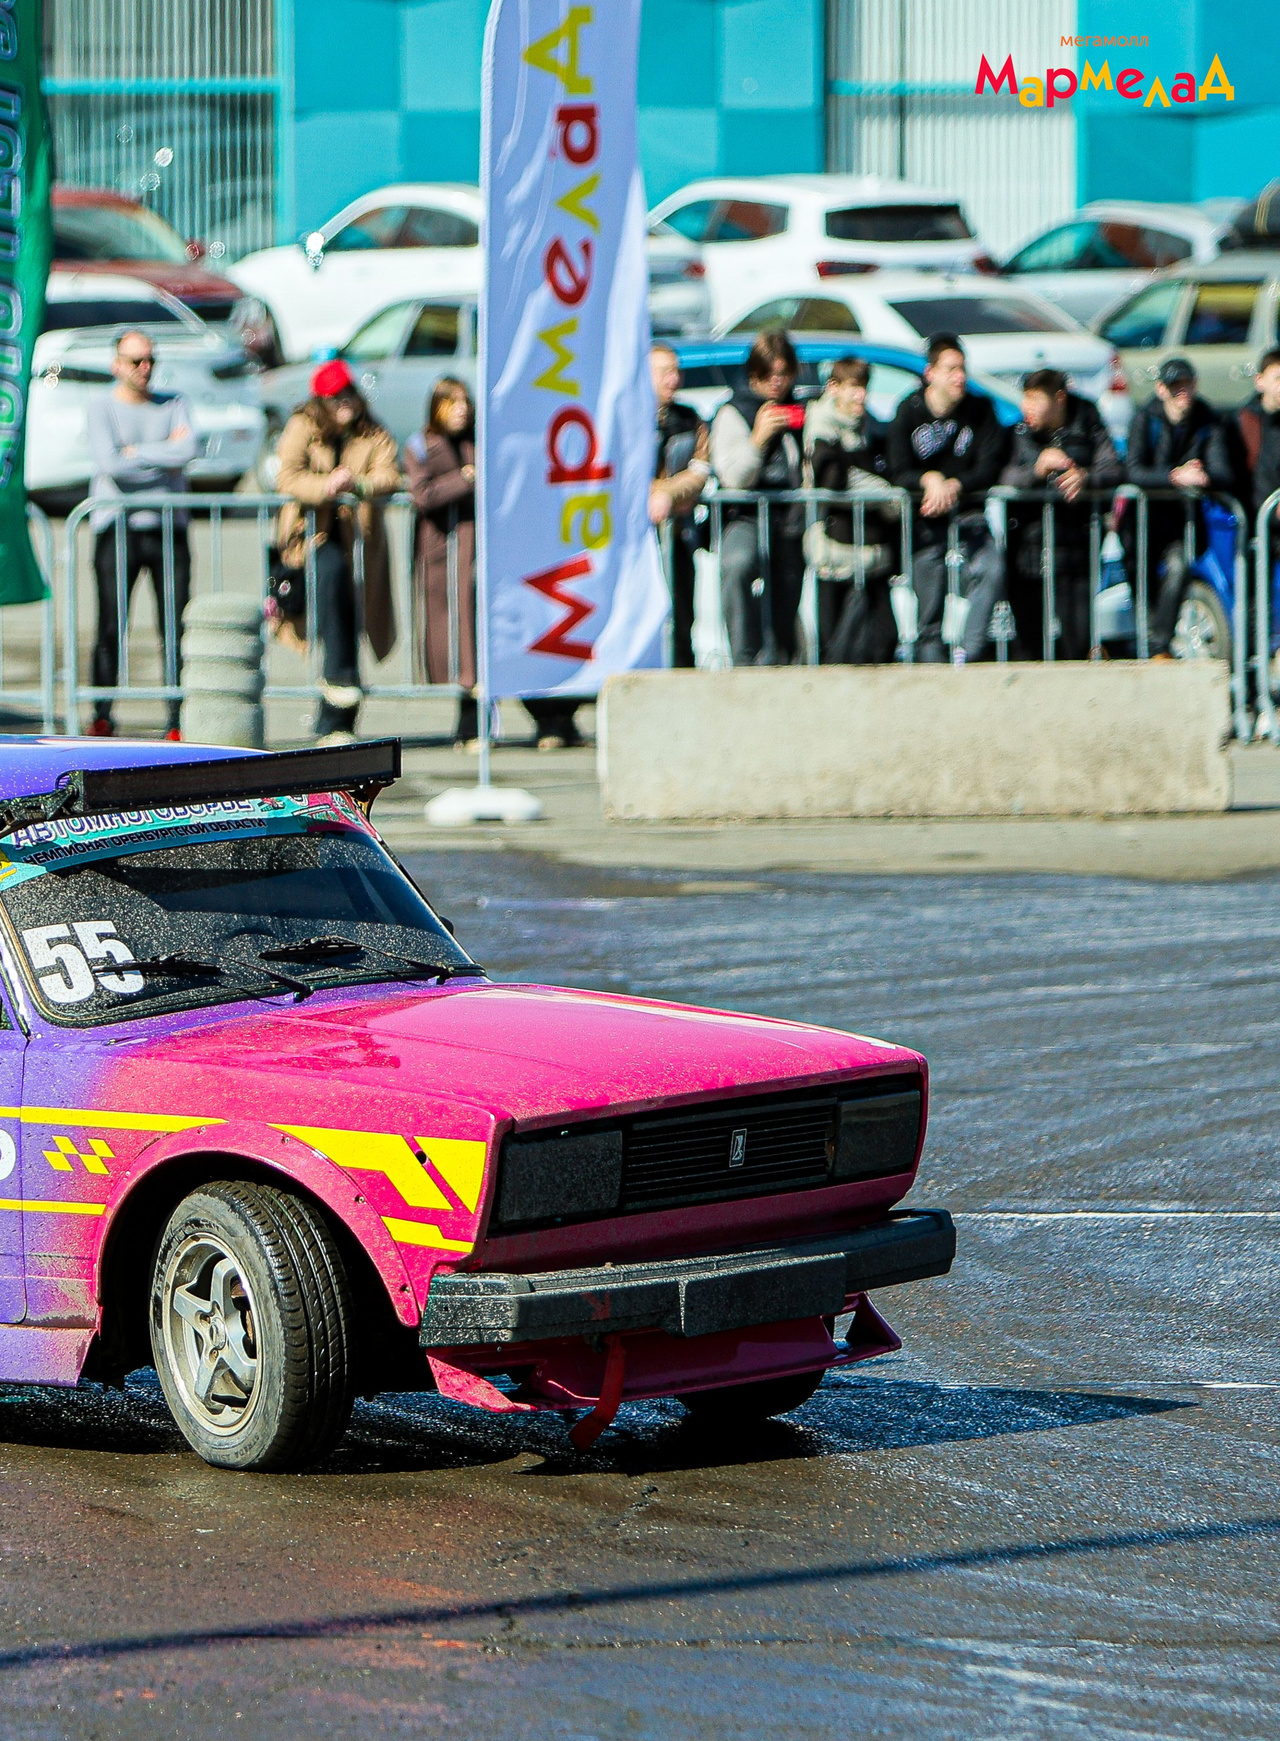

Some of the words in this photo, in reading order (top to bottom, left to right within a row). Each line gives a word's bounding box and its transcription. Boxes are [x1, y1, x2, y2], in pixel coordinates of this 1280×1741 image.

[21, 838, 112, 866] ЧЕМПИОНАТ
[112, 820, 211, 846] ОРЕНБУРГСКОЙ
[210, 817, 267, 833] ОБЛАСТИ
[20, 920, 145, 1003] 55
